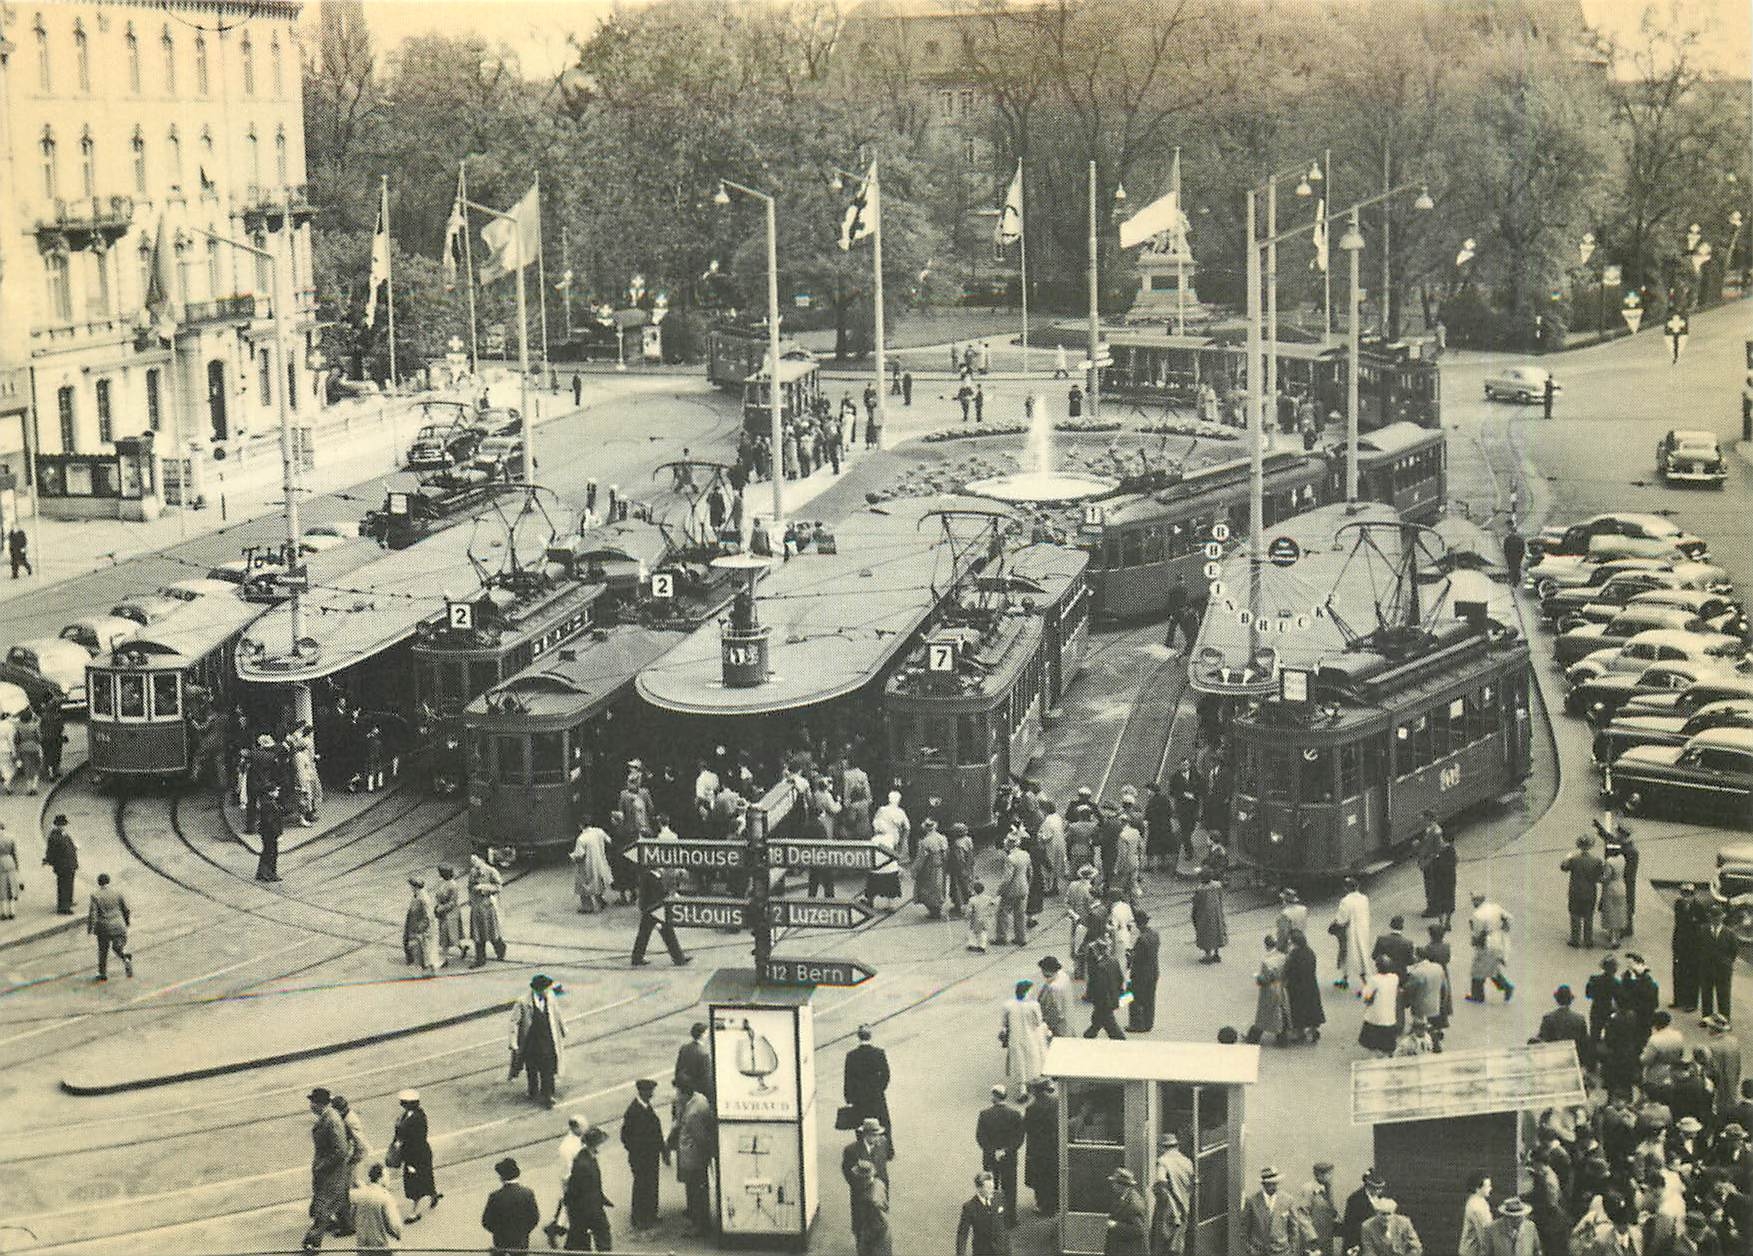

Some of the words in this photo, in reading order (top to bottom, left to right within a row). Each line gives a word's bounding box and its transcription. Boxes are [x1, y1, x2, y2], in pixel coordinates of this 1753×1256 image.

[658, 577, 668, 595] 2
[455, 608, 467, 625] 2
[936, 650, 947, 668] 7
[643, 846, 740, 866] Mulhouse
[768, 847, 783, 864] 18
[789, 904, 849, 924] Luzern
[797, 964, 844, 982] Bern
